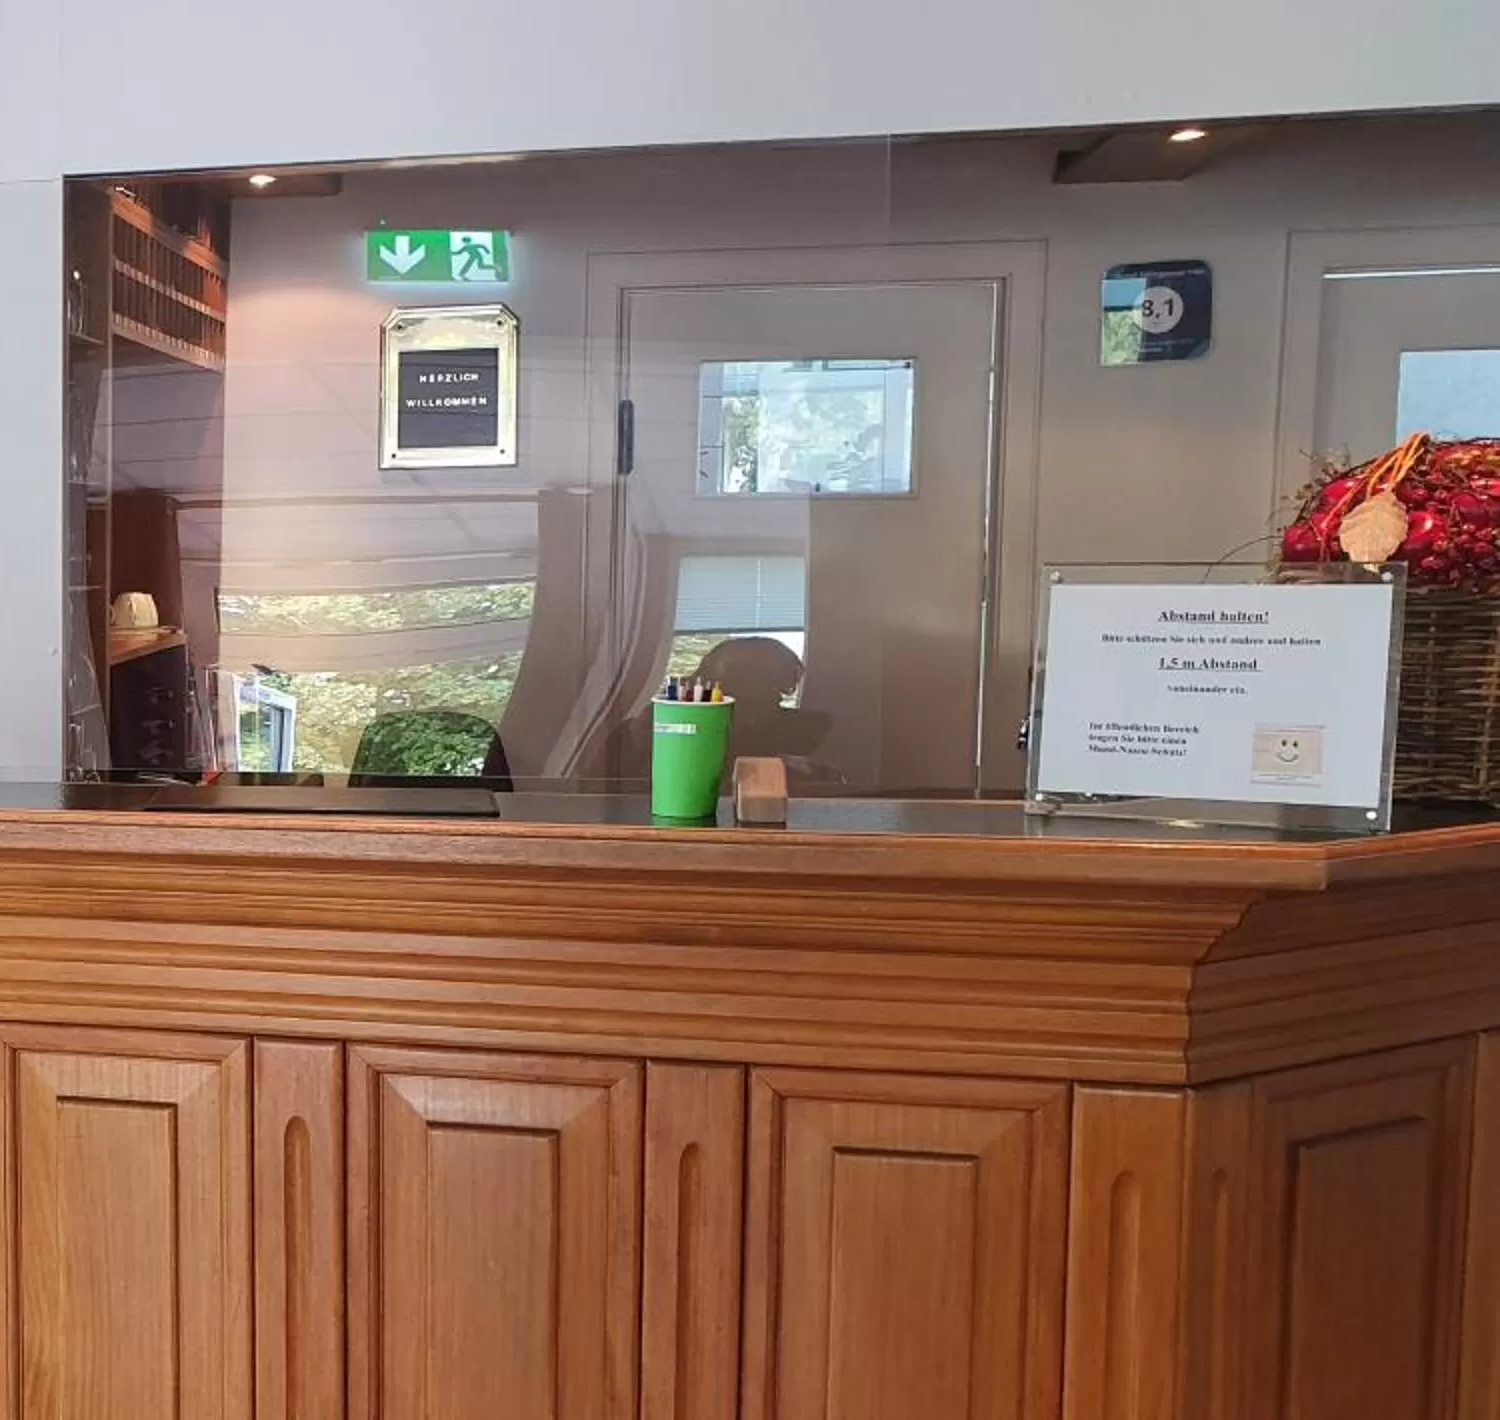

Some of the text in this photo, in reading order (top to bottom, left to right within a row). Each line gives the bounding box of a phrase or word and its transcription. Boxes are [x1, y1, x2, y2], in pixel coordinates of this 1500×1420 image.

[1141, 298, 1175, 319] 8,1
[419, 373, 479, 383] HERZLICH
[405, 397, 488, 408] WILLKOMMEN
[1157, 608, 1269, 624] Abstand halten!
[1158, 656, 1258, 671] 1,5 m Abstand
